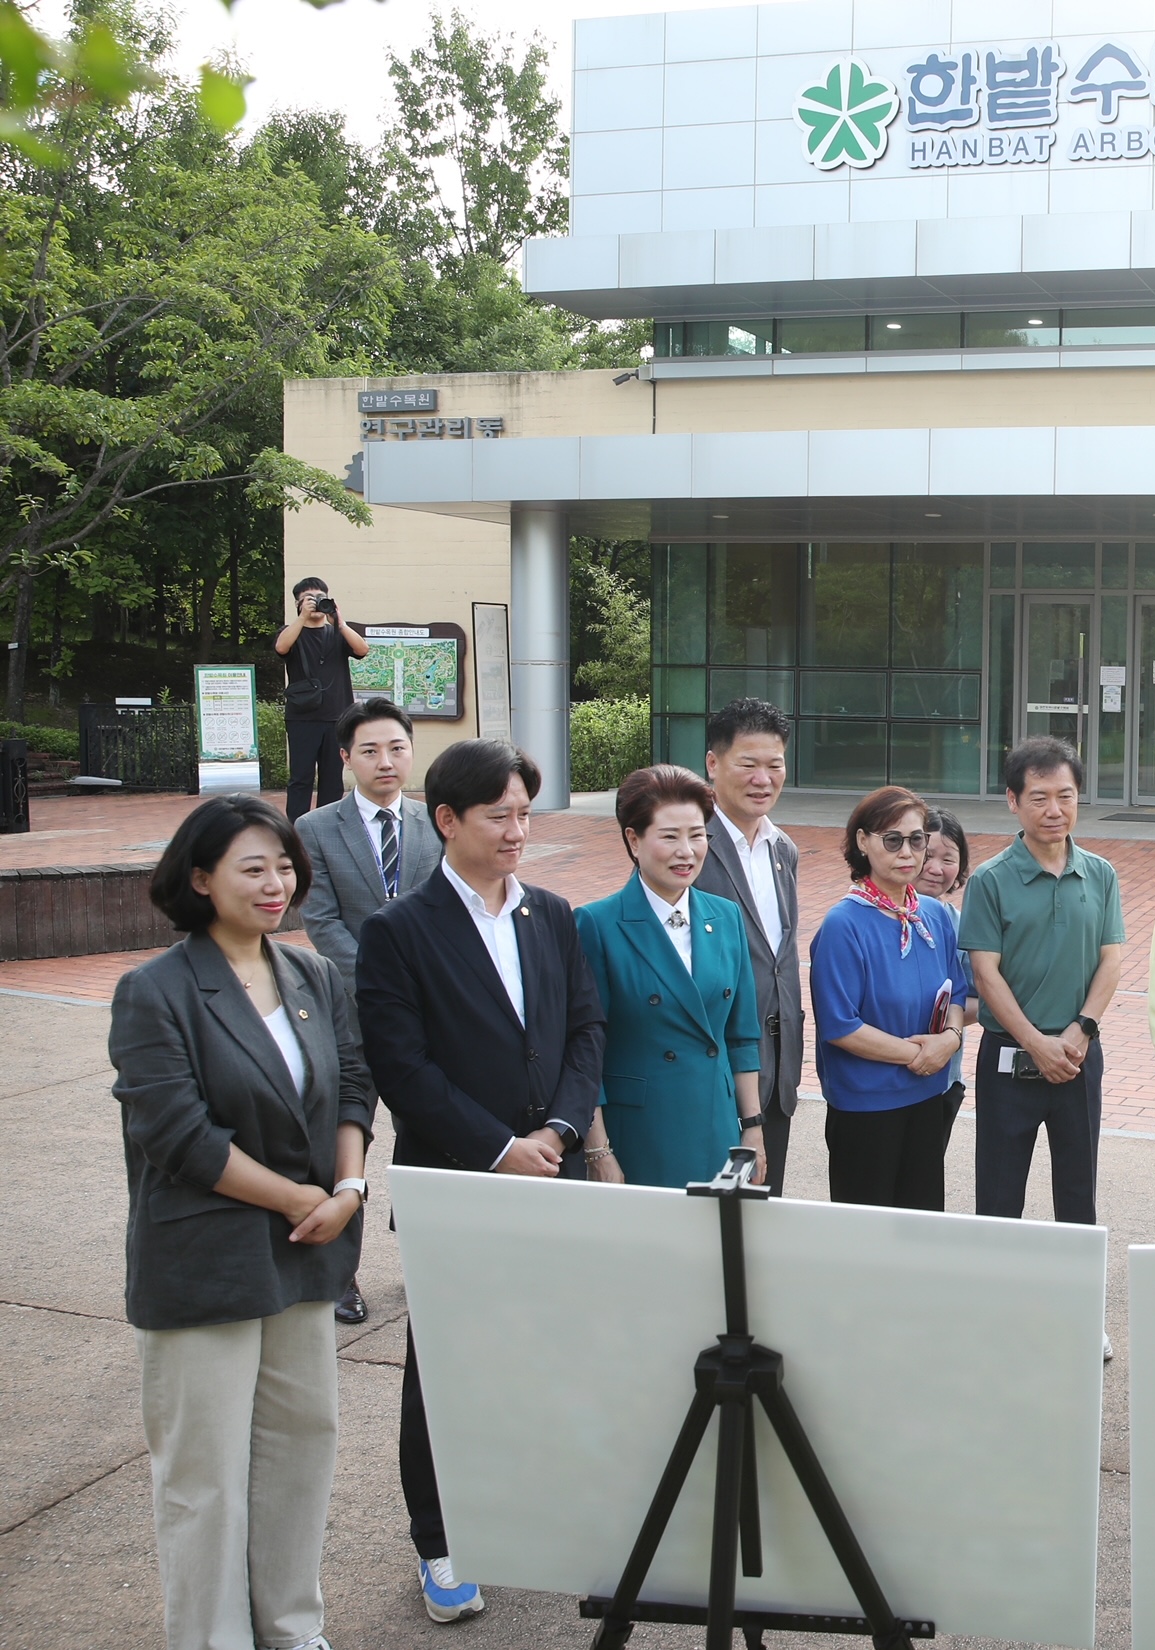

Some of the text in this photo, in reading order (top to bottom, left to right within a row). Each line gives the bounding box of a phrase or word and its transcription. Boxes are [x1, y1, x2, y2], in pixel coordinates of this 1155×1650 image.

[910, 134, 1048, 162] HANBAT
[361, 393, 430, 408] 한밭수목원
[360, 416, 504, 442] 연구관리동
